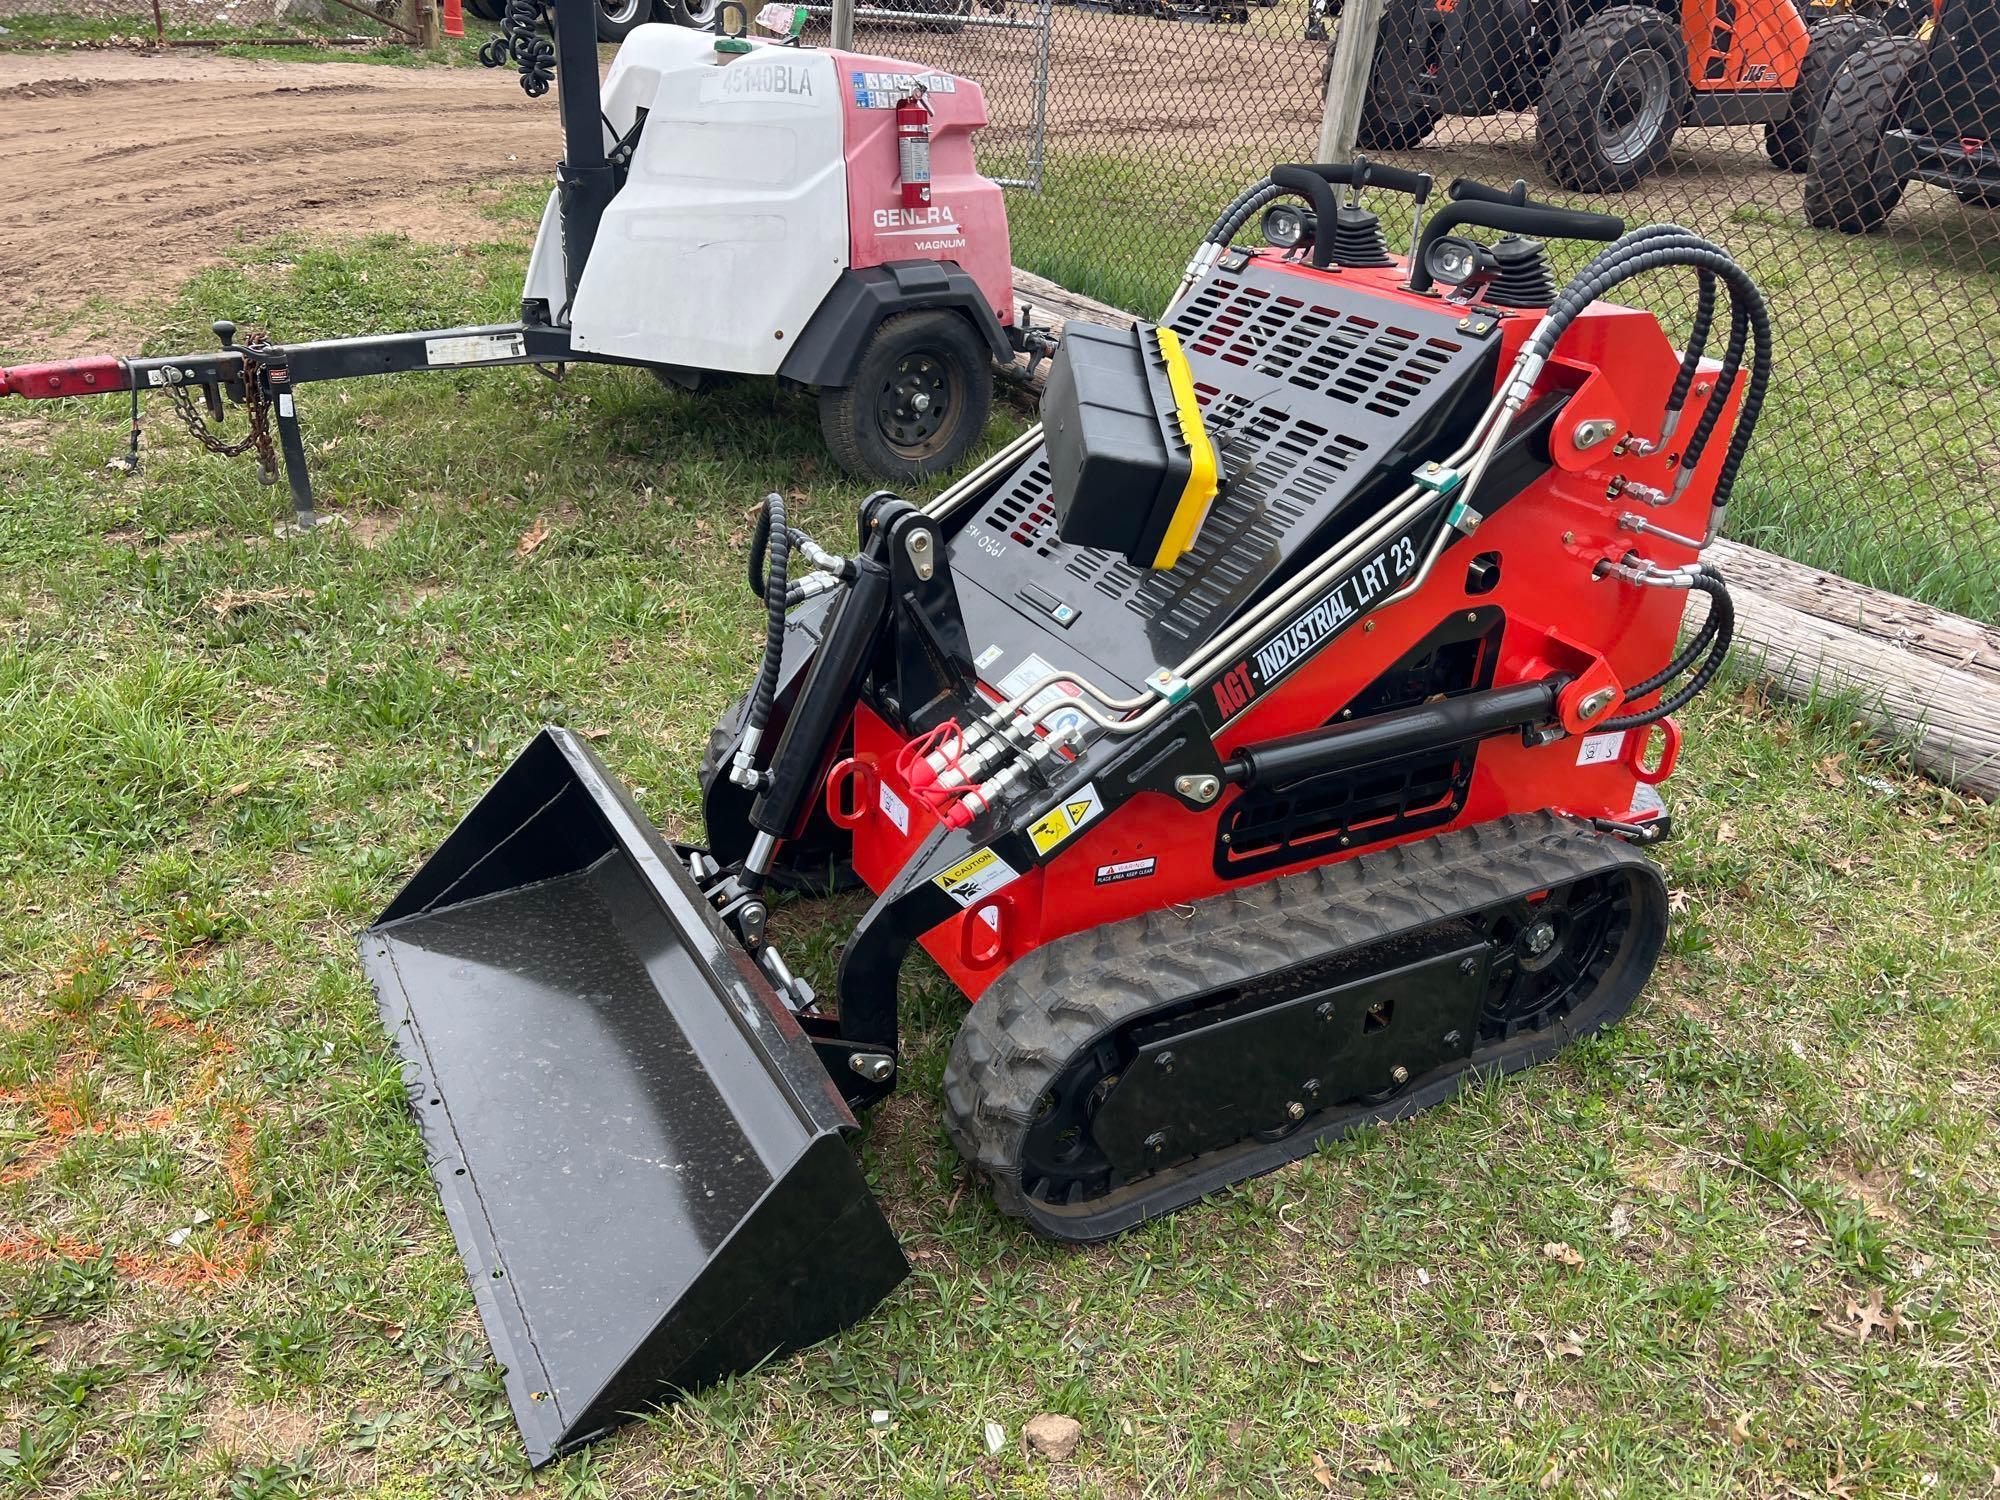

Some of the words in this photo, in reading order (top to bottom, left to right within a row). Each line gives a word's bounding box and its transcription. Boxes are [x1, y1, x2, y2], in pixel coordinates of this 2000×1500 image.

[914, 238, 966, 251] MAGNUM
[1256, 590, 1353, 681] INDUSTRIAL
[1351, 552, 1391, 606] LRT
[1390, 536, 1416, 577] 23
[954, 853, 992, 877] CAUTION
